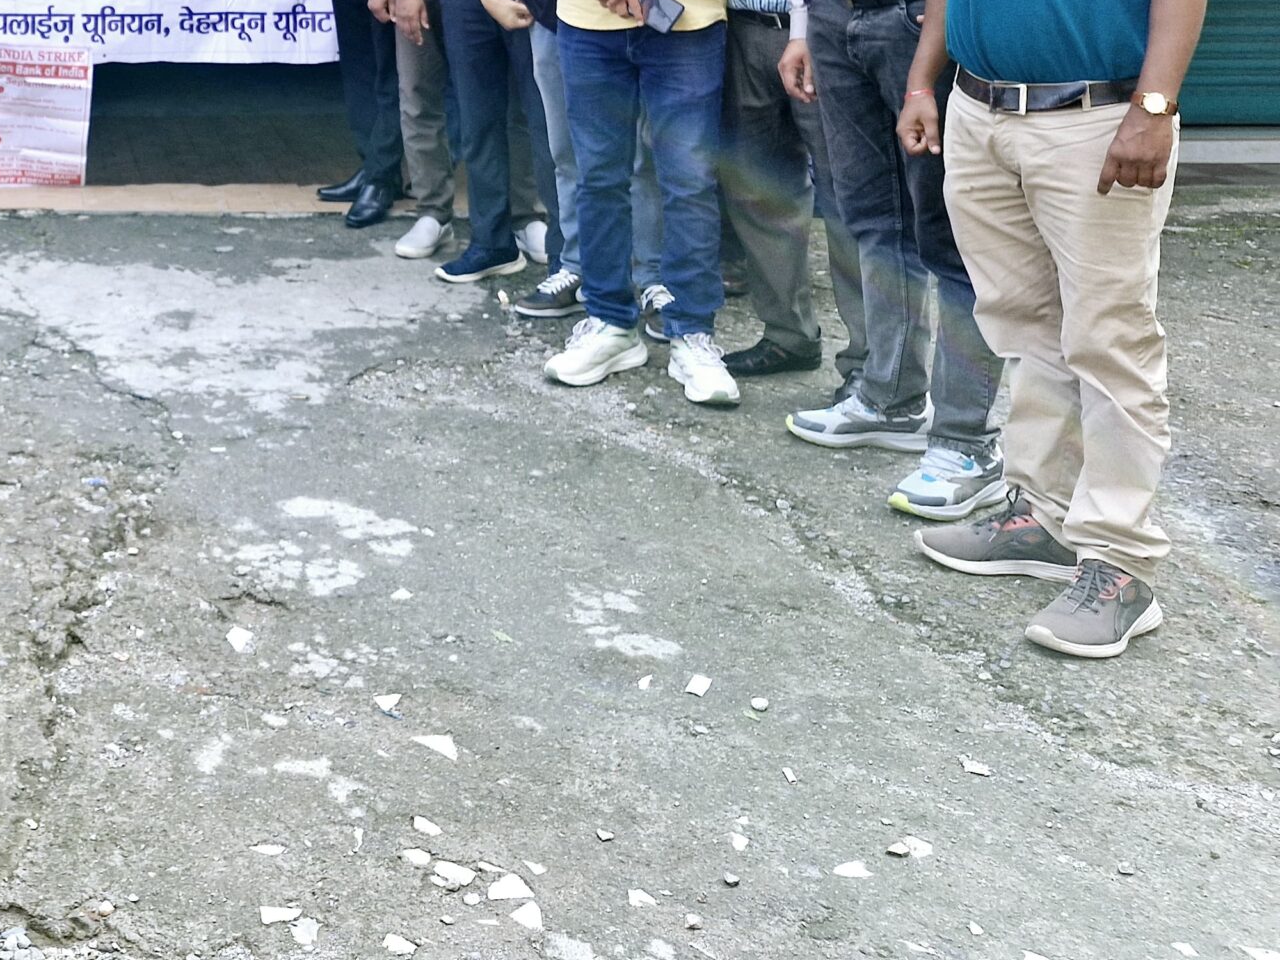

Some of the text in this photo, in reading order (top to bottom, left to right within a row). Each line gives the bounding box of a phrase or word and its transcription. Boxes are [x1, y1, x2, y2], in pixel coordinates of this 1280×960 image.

[82, 6, 170, 44] यूनियन,
[179, 6, 267, 40] देहरादून
[273, 3, 334, 42] यूनिट
[0, 48, 34, 61] INDIA
[38, 51, 85, 62] STRIKE
[15, 65, 42, 77] Bank
[44, 66, 56, 77] of
[58, 67, 85, 78] India
